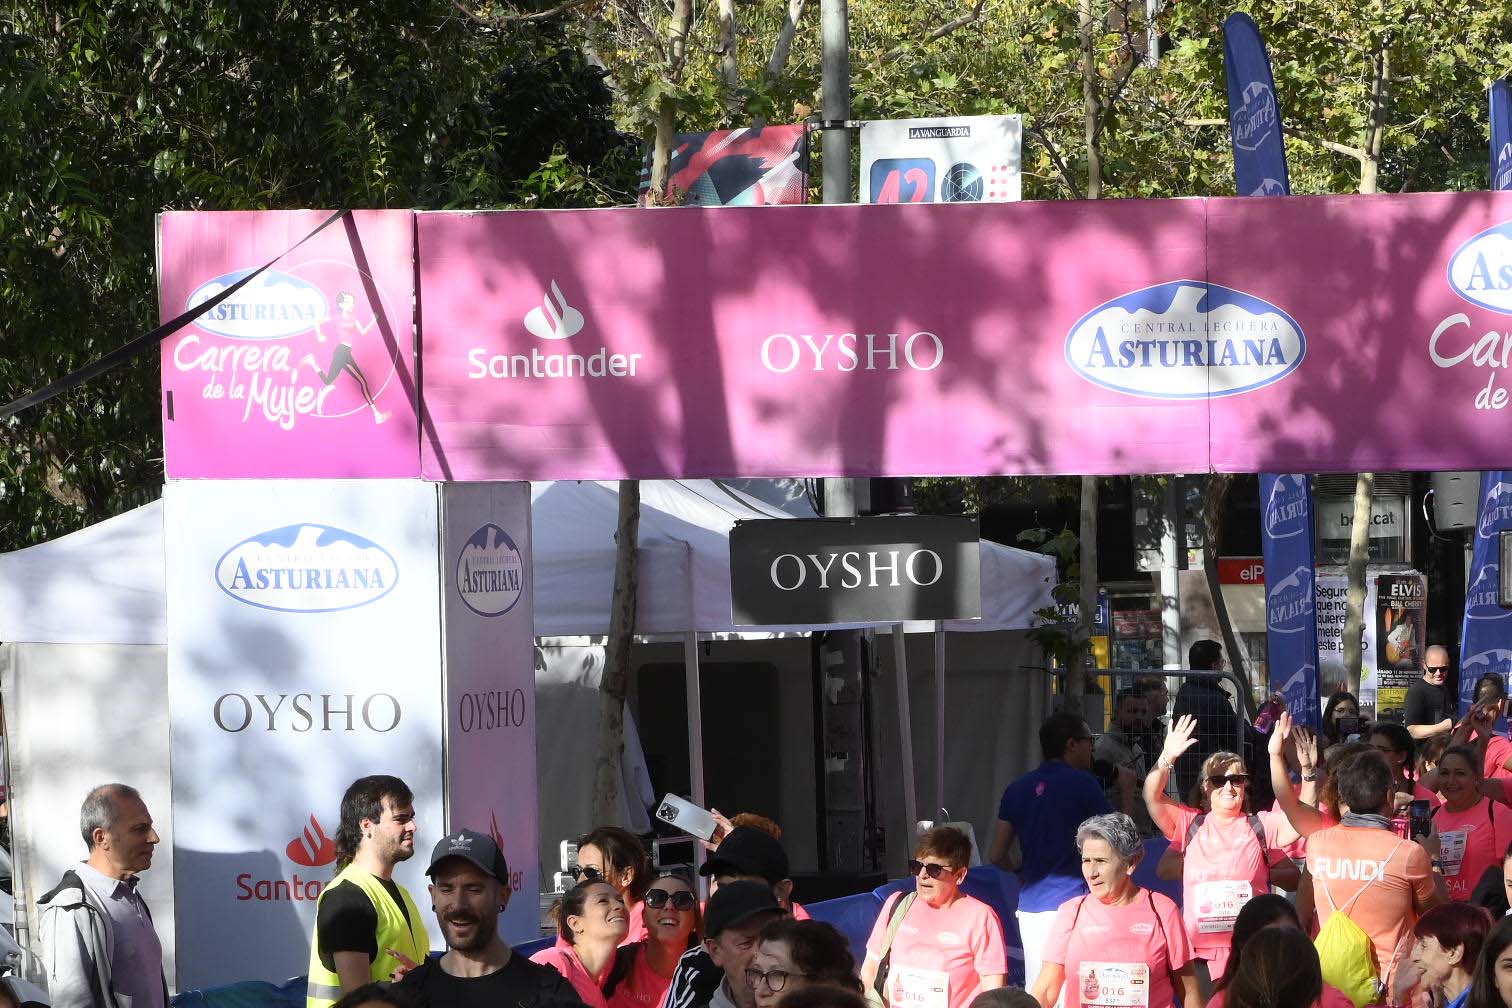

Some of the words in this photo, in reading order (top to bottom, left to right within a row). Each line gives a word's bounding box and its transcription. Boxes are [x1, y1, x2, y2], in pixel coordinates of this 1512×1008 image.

[922, 127, 970, 138] VANGUARDIA
[1121, 321, 1197, 335] CENTRAL
[1203, 319, 1280, 334] LECHERA
[173, 336, 291, 373] Carrera
[468, 348, 642, 379] Santander
[759, 331, 944, 374] OYSHO
[1085, 325, 1288, 370] ASTURIANA
[203, 377, 226, 400] de
[229, 376, 246, 399] la
[242, 370, 339, 430] Mujer
[1474, 379, 1510, 411] de
[230, 557, 386, 590] ASTURIANA
[462, 564, 521, 594] ASTURIANA
[770, 549, 944, 591] OYSHO
[1391, 584, 1422, 597] ELVIS
[1317, 602, 1334, 615] que
[1318, 640, 1336, 651] este
[213, 692, 402, 733] OYSHO
[459, 687, 527, 733] OYSHO
[1102, 987, 1125, 996] 016
